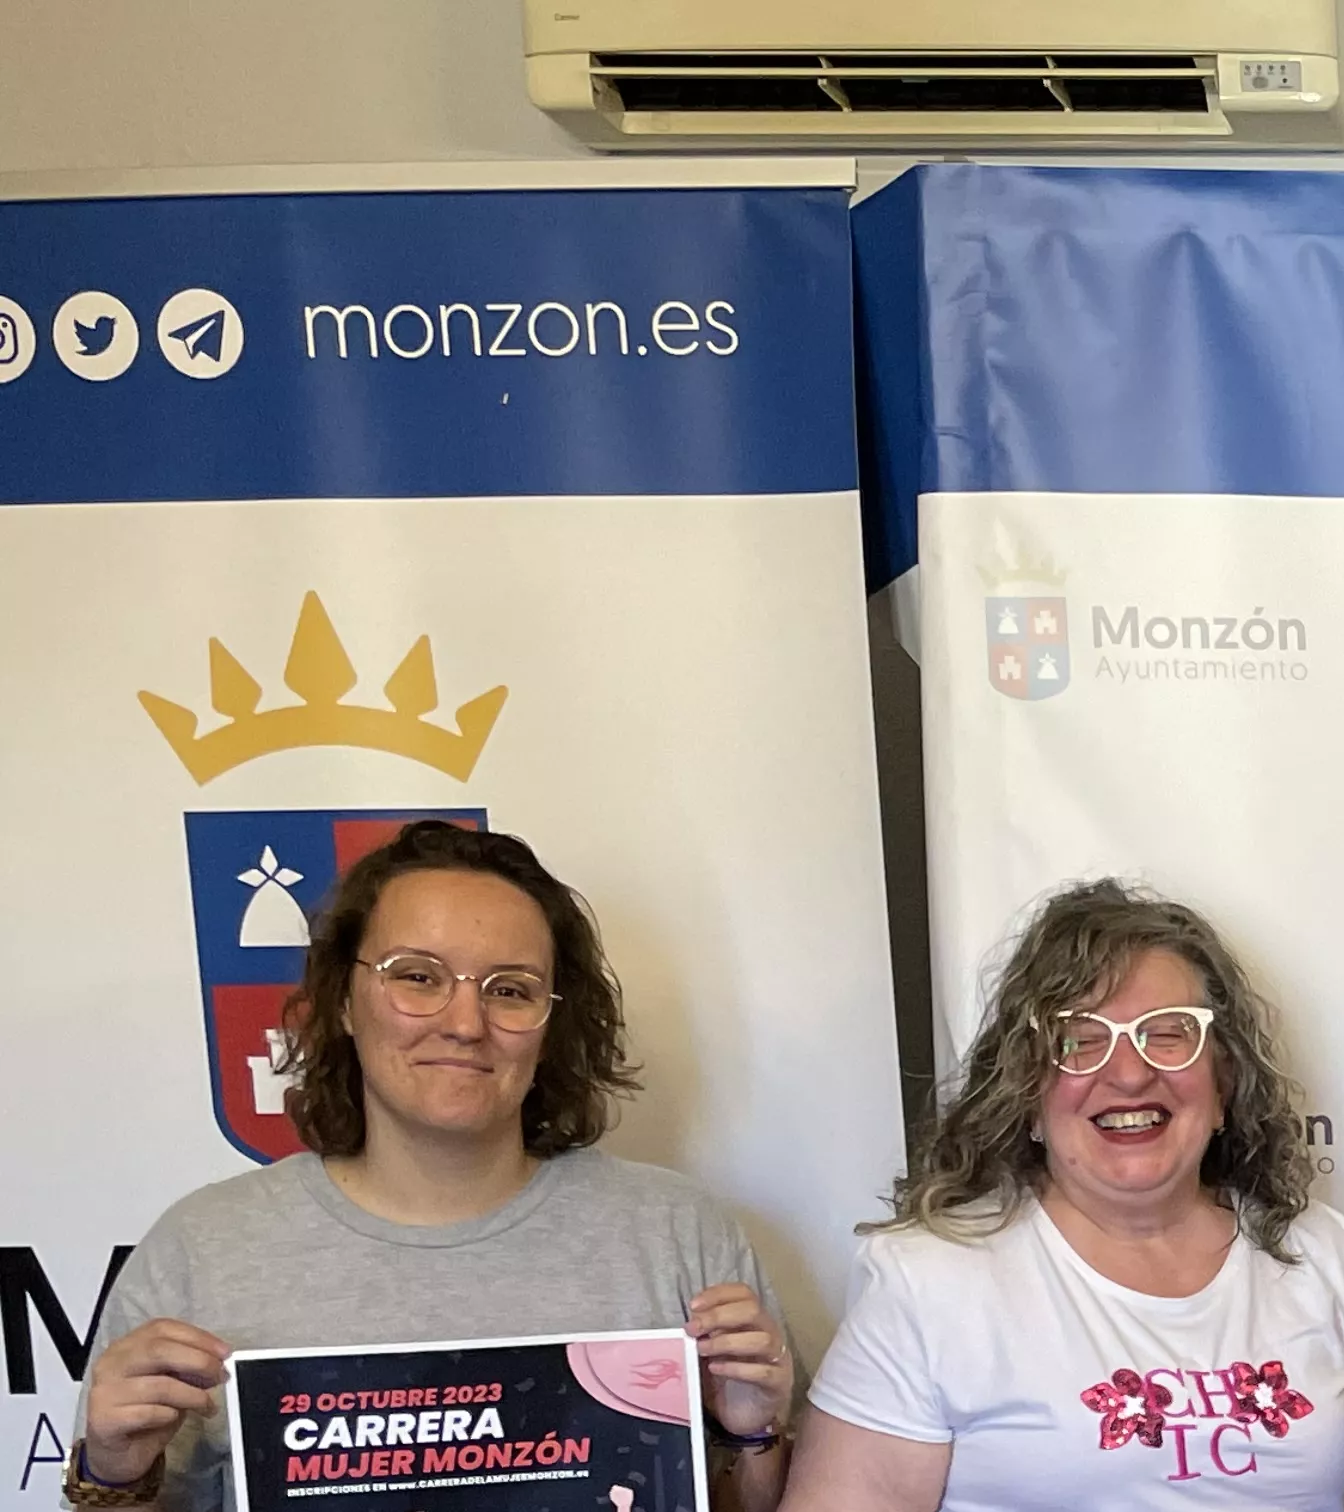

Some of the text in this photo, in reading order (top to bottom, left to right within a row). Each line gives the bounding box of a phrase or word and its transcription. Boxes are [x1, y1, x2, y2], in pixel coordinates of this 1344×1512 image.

[303, 299, 740, 360] monzon.es
[1092, 606, 1308, 650] Monzón
[1094, 654, 1308, 684] Ayuntamiento
[280, 1383, 502, 1414] 29 OCTUBRE 2023
[1145, 1368, 1239, 1420] CH
[283, 1407, 504, 1451] CARRERA
[286, 1431, 590, 1482] MUJER MONZÓN
[1159, 1423, 1258, 1481] IC
[287, 1482, 370, 1497] INSCRIPCIONES
[372, 1482, 387, 1491] EN
